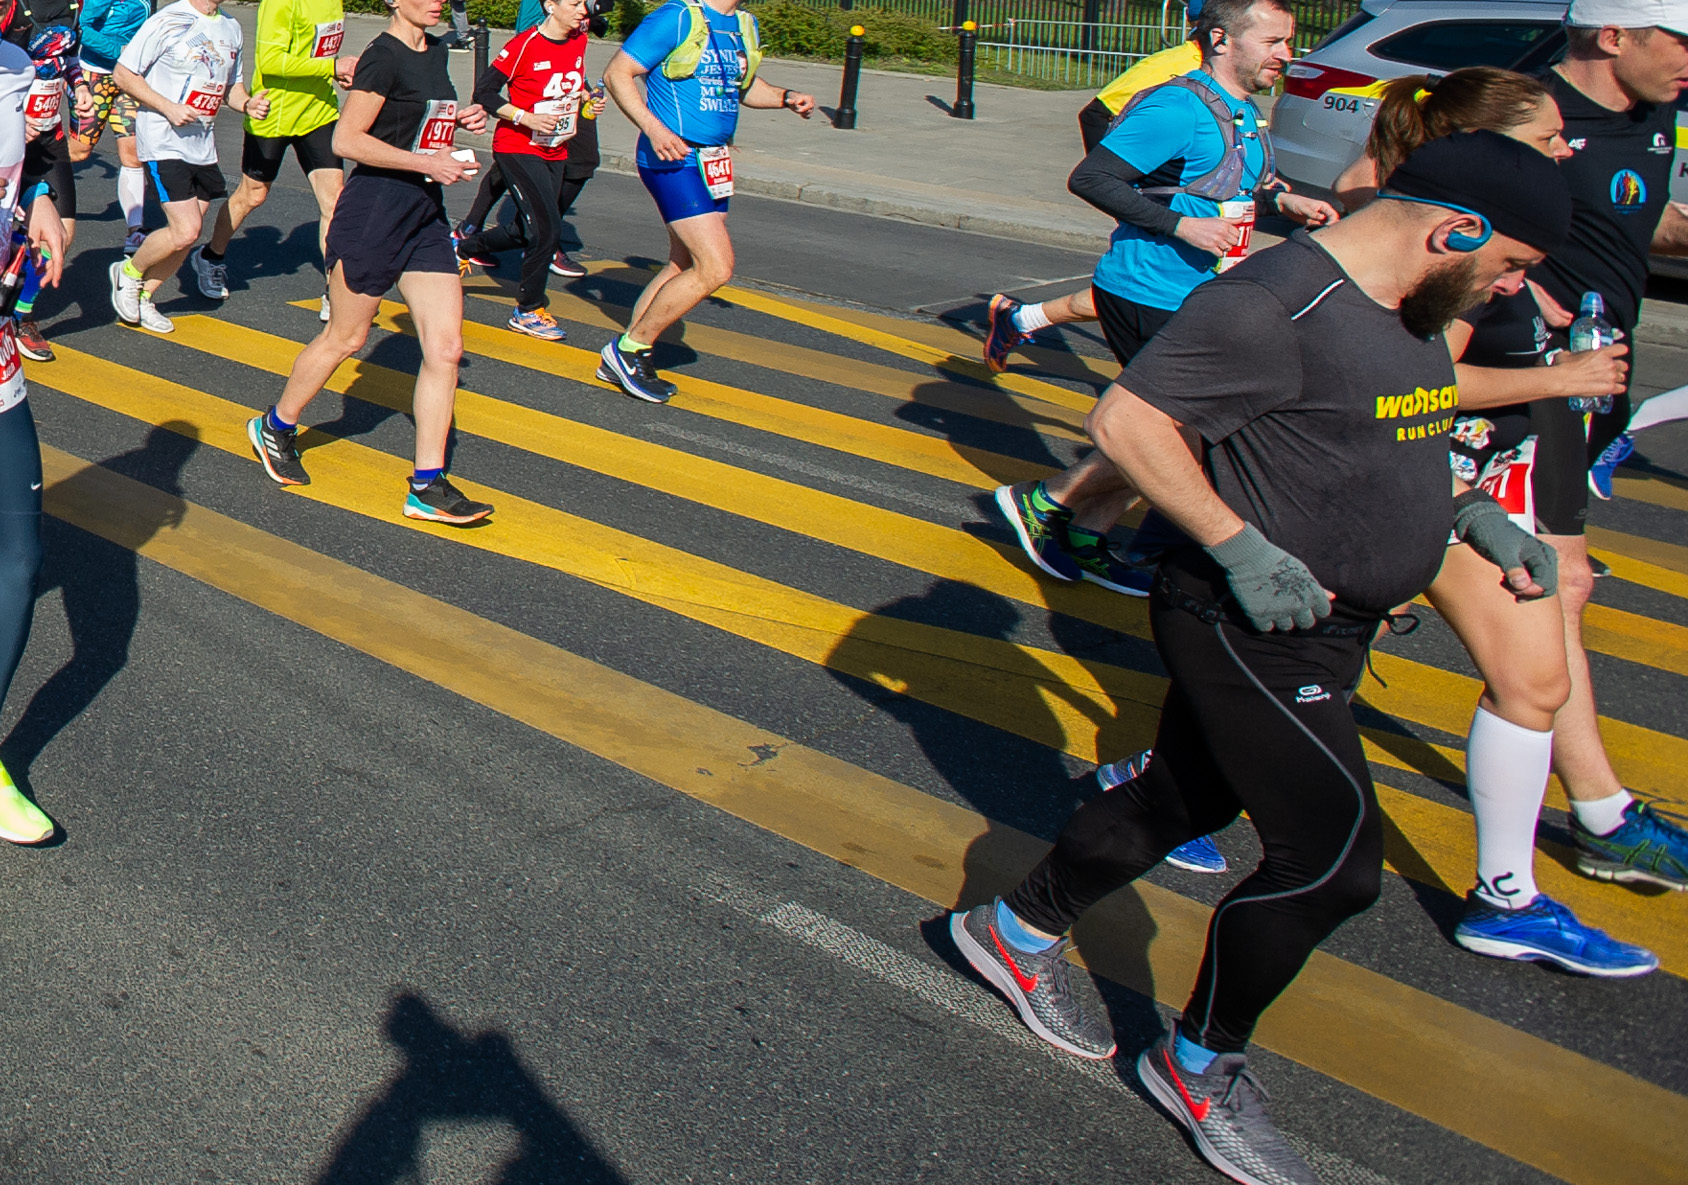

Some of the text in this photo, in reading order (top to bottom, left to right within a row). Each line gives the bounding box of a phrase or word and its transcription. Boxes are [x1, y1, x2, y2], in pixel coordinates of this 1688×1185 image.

[1323, 95, 1359, 113] 904
[427, 121, 455, 141] 1977
[1397, 425, 1426, 441] RUN
